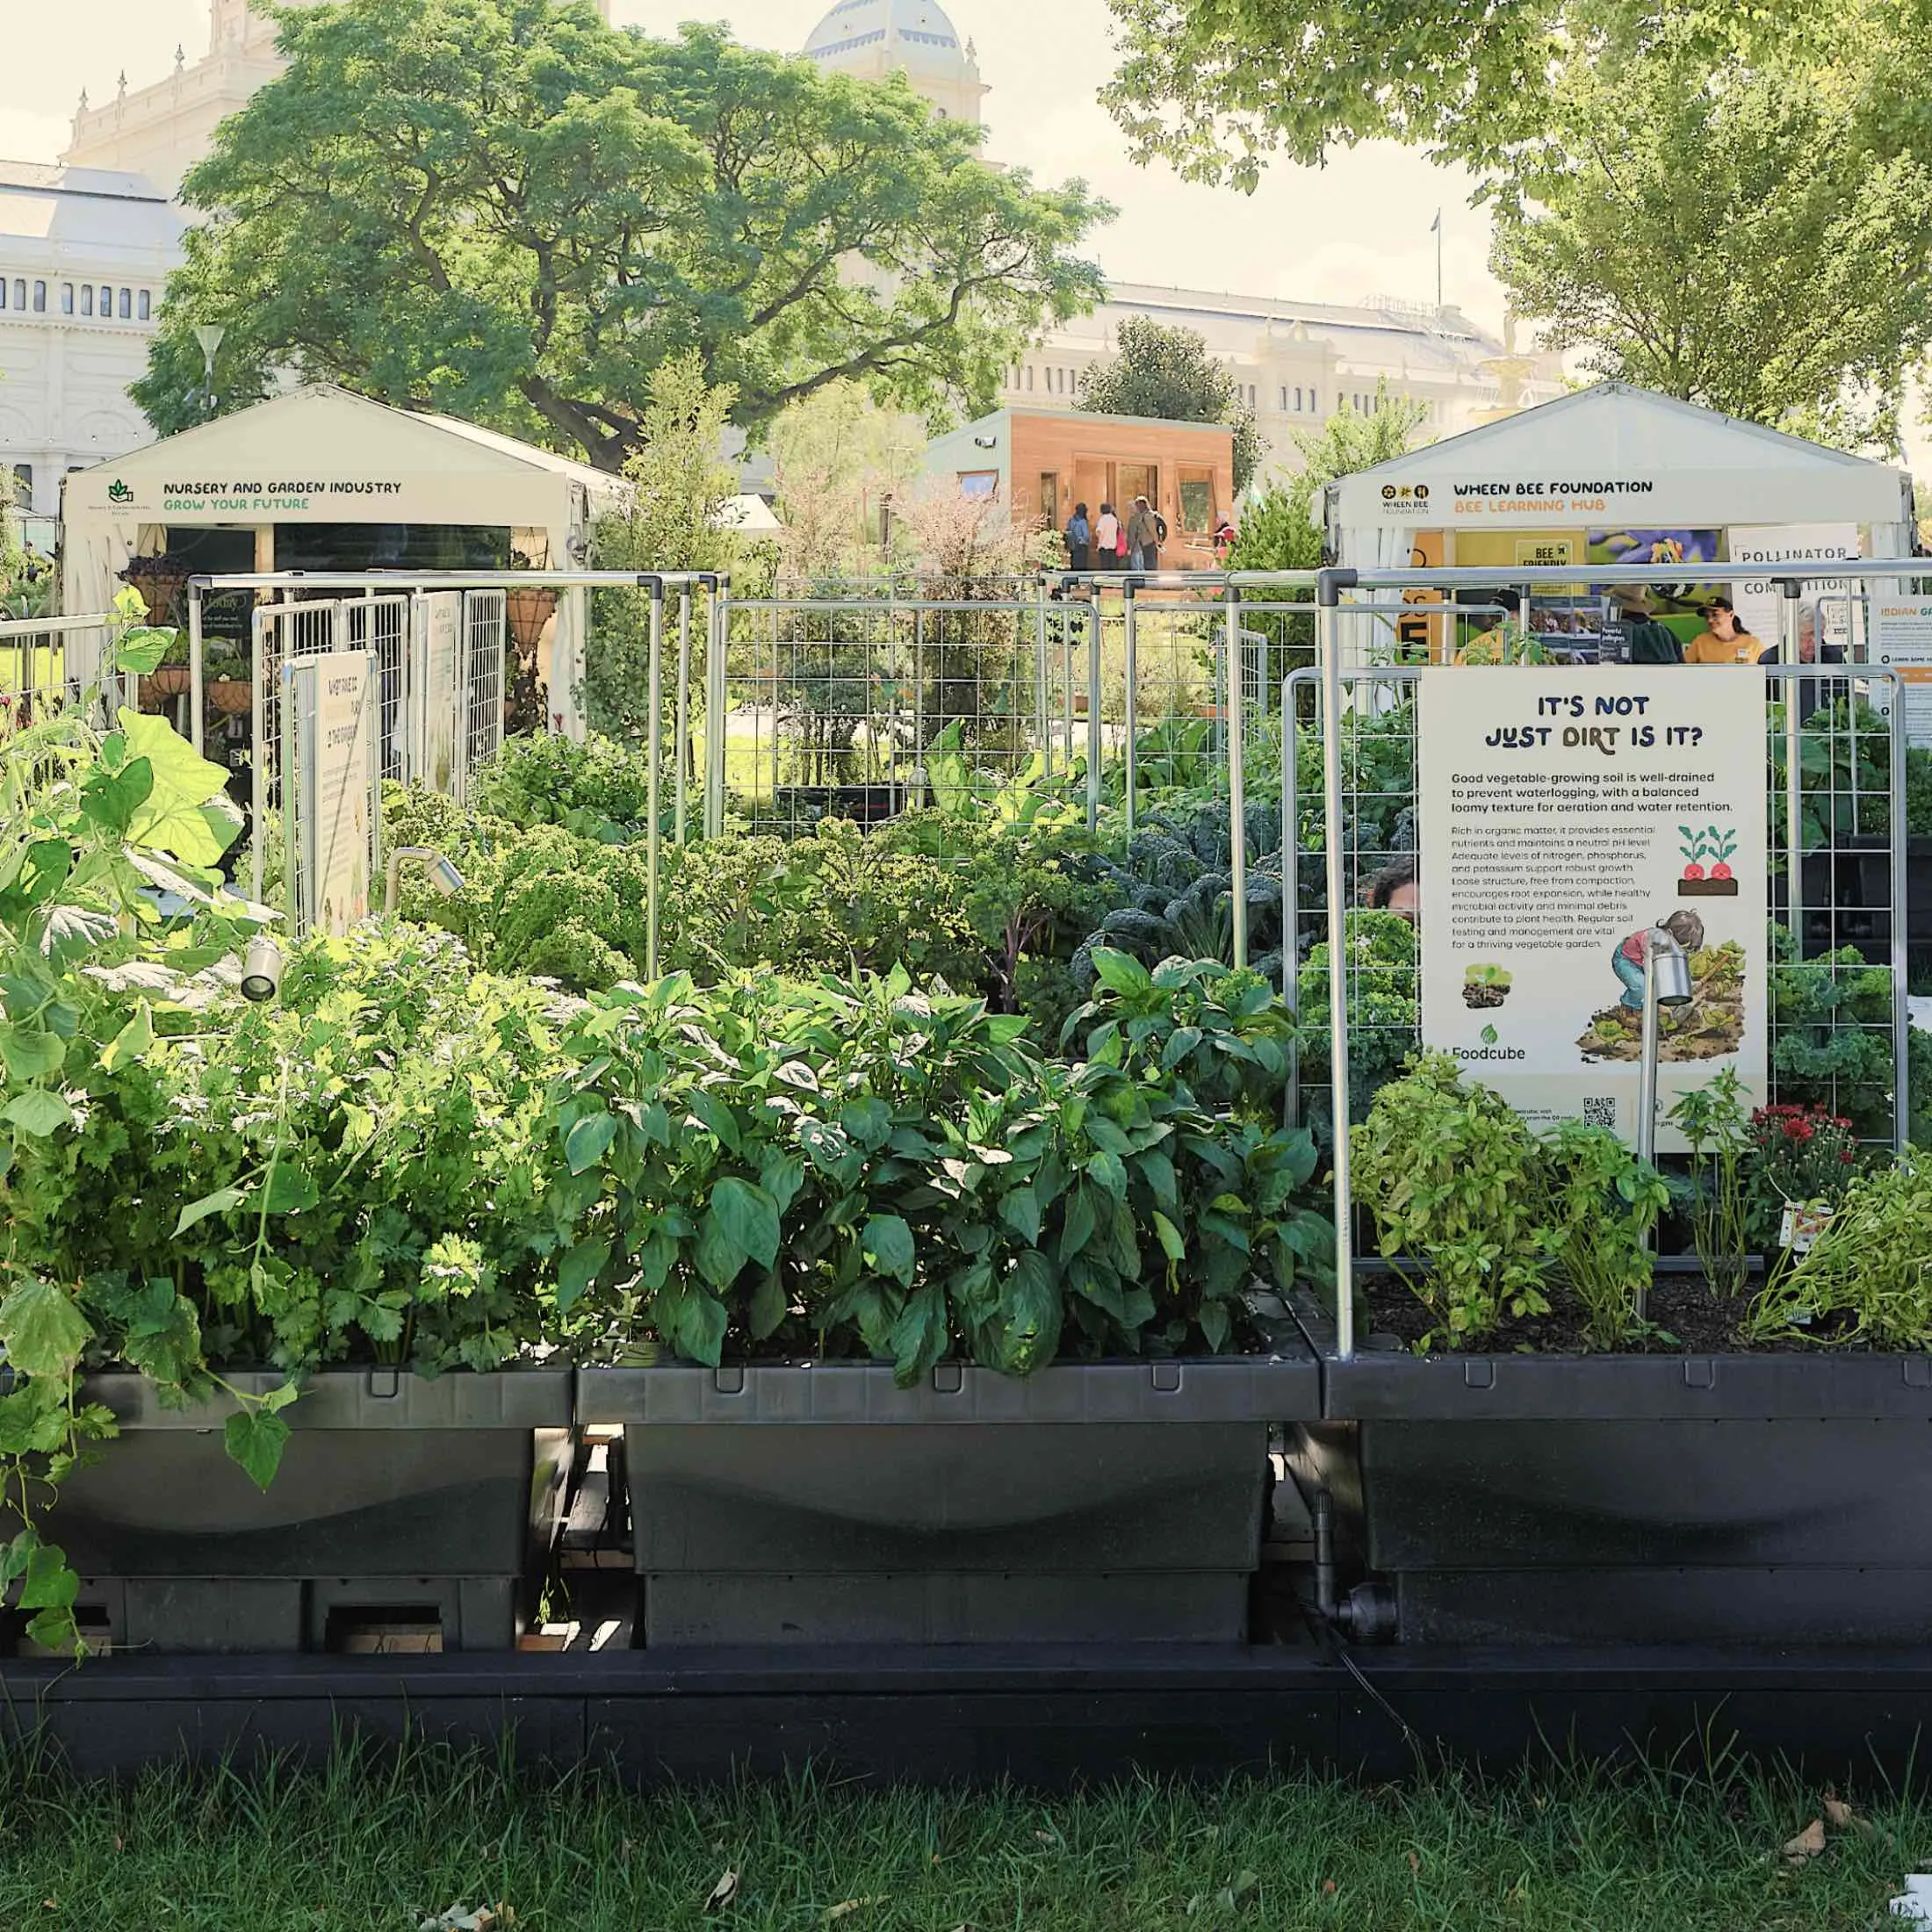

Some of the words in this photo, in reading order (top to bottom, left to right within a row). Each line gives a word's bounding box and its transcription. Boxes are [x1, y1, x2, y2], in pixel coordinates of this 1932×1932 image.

[163, 482, 228, 494] NURSERY
[233, 482, 263, 494] AND
[268, 481, 325, 494] GARDEN
[329, 481, 402, 494] INDUSTRY
[1453, 483, 1510, 496] WHEEN
[1516, 482, 1545, 495] BEE
[1549, 480, 1654, 494] FOUNDATION
[163, 498, 206, 510] GROW
[211, 498, 247, 510] YOUR
[253, 498, 309, 510] FUTURE
[1454, 500, 1483, 513] BEE
[1489, 499, 1565, 513] LEARNING
[1570, 497, 1606, 512] HUB
[1535, 547, 1554, 559] BEE
[1741, 547, 1847, 563] POLLINATOR
[1744, 579, 1848, 595] COMITION
[1881, 607, 1918, 616] INDIAN
[1539, 696, 1585, 717] IT'S
[1595, 696, 1649, 716] NOT
[1485, 726, 1552, 748] JUST
[1562, 726, 1620, 755] DIRT
[1631, 725, 1654, 747] IS
[1667, 726, 1703, 746] IT?
[1452, 773, 1483, 783] Good
[1486, 772, 1599, 785] vegetable-growing
[1603, 773, 1624, 782] soil
[1626, 773, 1637, 782] is
[1640, 773, 1714, 782] well-drained
[1467, 789, 1513, 800] prevent
[1516, 788, 1599, 799] waterlogging,
[1602, 788, 1628, 797] with
[1642, 787, 1699, 797] balanced
[1452, 803, 1489, 815] loamy
[1492, 803, 1534, 812] texture
[1538, 803, 1554, 812] for
[1557, 802, 1609, 812] aeration
[1611, 802, 1634, 812] and
[1637, 802, 1672, 811] water
[1676, 801, 1733, 812] retention.
[1452, 825, 1472, 835] Rich
[1485, 826, 1522, 837] organic
[1568, 825, 1609, 835] provides
[1612, 825, 1655, 834] essential
[1452, 839, 1495, 847] nutrients
[1496, 839, 1516, 847] and
[1517, 839, 1565, 847] maintains
[1576, 839, 1611, 847] neutral
[1612, 839, 1626, 848] pH
[1452, 852, 1498, 861] Adequate
[1501, 851, 1529, 861] levels
[1531, 851, 1539, 860] of
[1587, 852, 1647, 861] phosphorus,
[1473, 865, 1523, 874] potassium
[1525, 864, 1562, 874] support
[1481, 877, 1528, 886] structure,
[1530, 876, 1549, 885] free
[1551, 876, 1574, 885] from
[1452, 890, 1509, 899] encourages
[1588, 889, 1612, 898] while
[1615, 889, 1651, 898] healthy
[1452, 902, 1496, 911] microbial
[1498, 902, 1533, 912] activity
[1536, 902, 1555, 911] and
[1557, 902, 1595, 911] minimal
[1597, 901, 1628, 911] debris
[1452, 915, 1502, 924] contribute
[1516, 915, 1540, 924] plant
[1577, 914, 1614, 924] Regular
[1617, 914, 1633, 923] soil
[1452, 927, 1485, 937] testing
[1488, 927, 1506, 936] and
[1509, 927, 1575, 937] management
[1595, 926, 1615, 935] vital
[1452, 941, 1466, 949] for
[1476, 940, 1512, 949] thriving
[1515, 940, 1563, 949] vegetable
[1452, 1047, 1526, 1061] Foodcube
